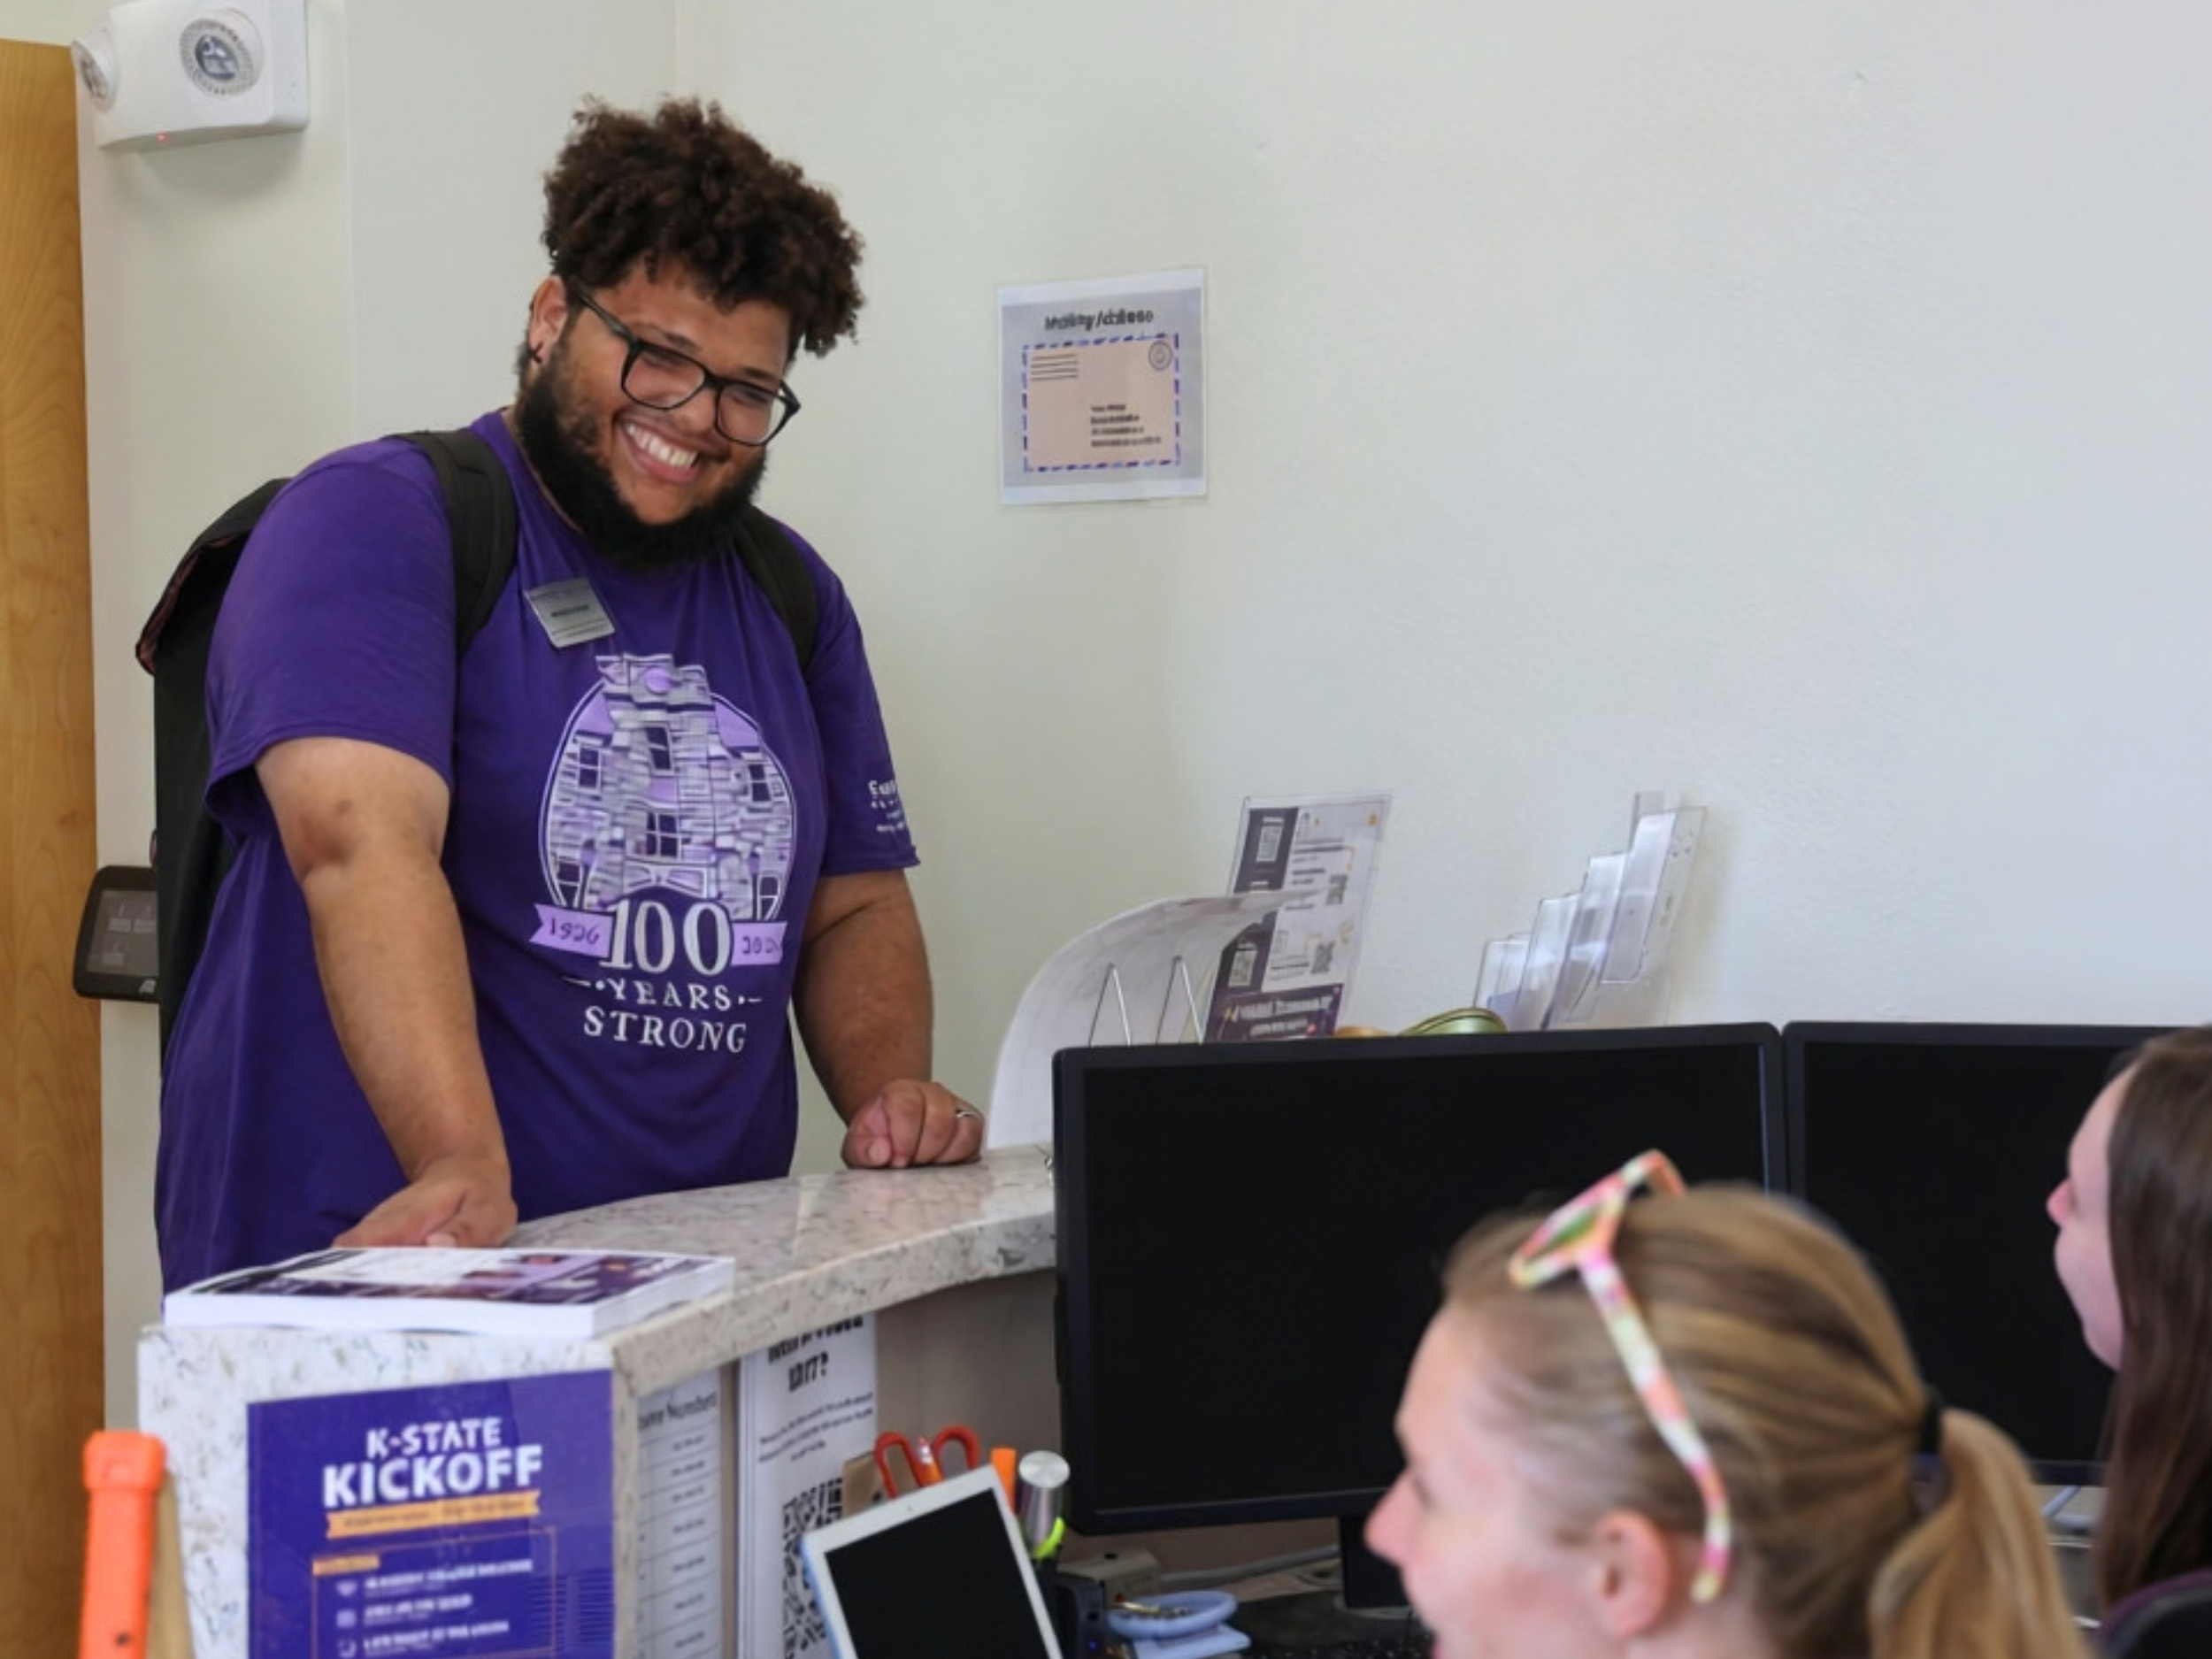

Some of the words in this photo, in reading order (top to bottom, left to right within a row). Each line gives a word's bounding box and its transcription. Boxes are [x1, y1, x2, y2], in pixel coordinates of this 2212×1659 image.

[599, 899, 731, 976] 100
[607, 978, 732, 1011] YEARS
[584, 1006, 746, 1053] STRONG
[366, 1417, 503, 1459] K-STATE
[323, 1444, 543, 1509] KICKOFF
